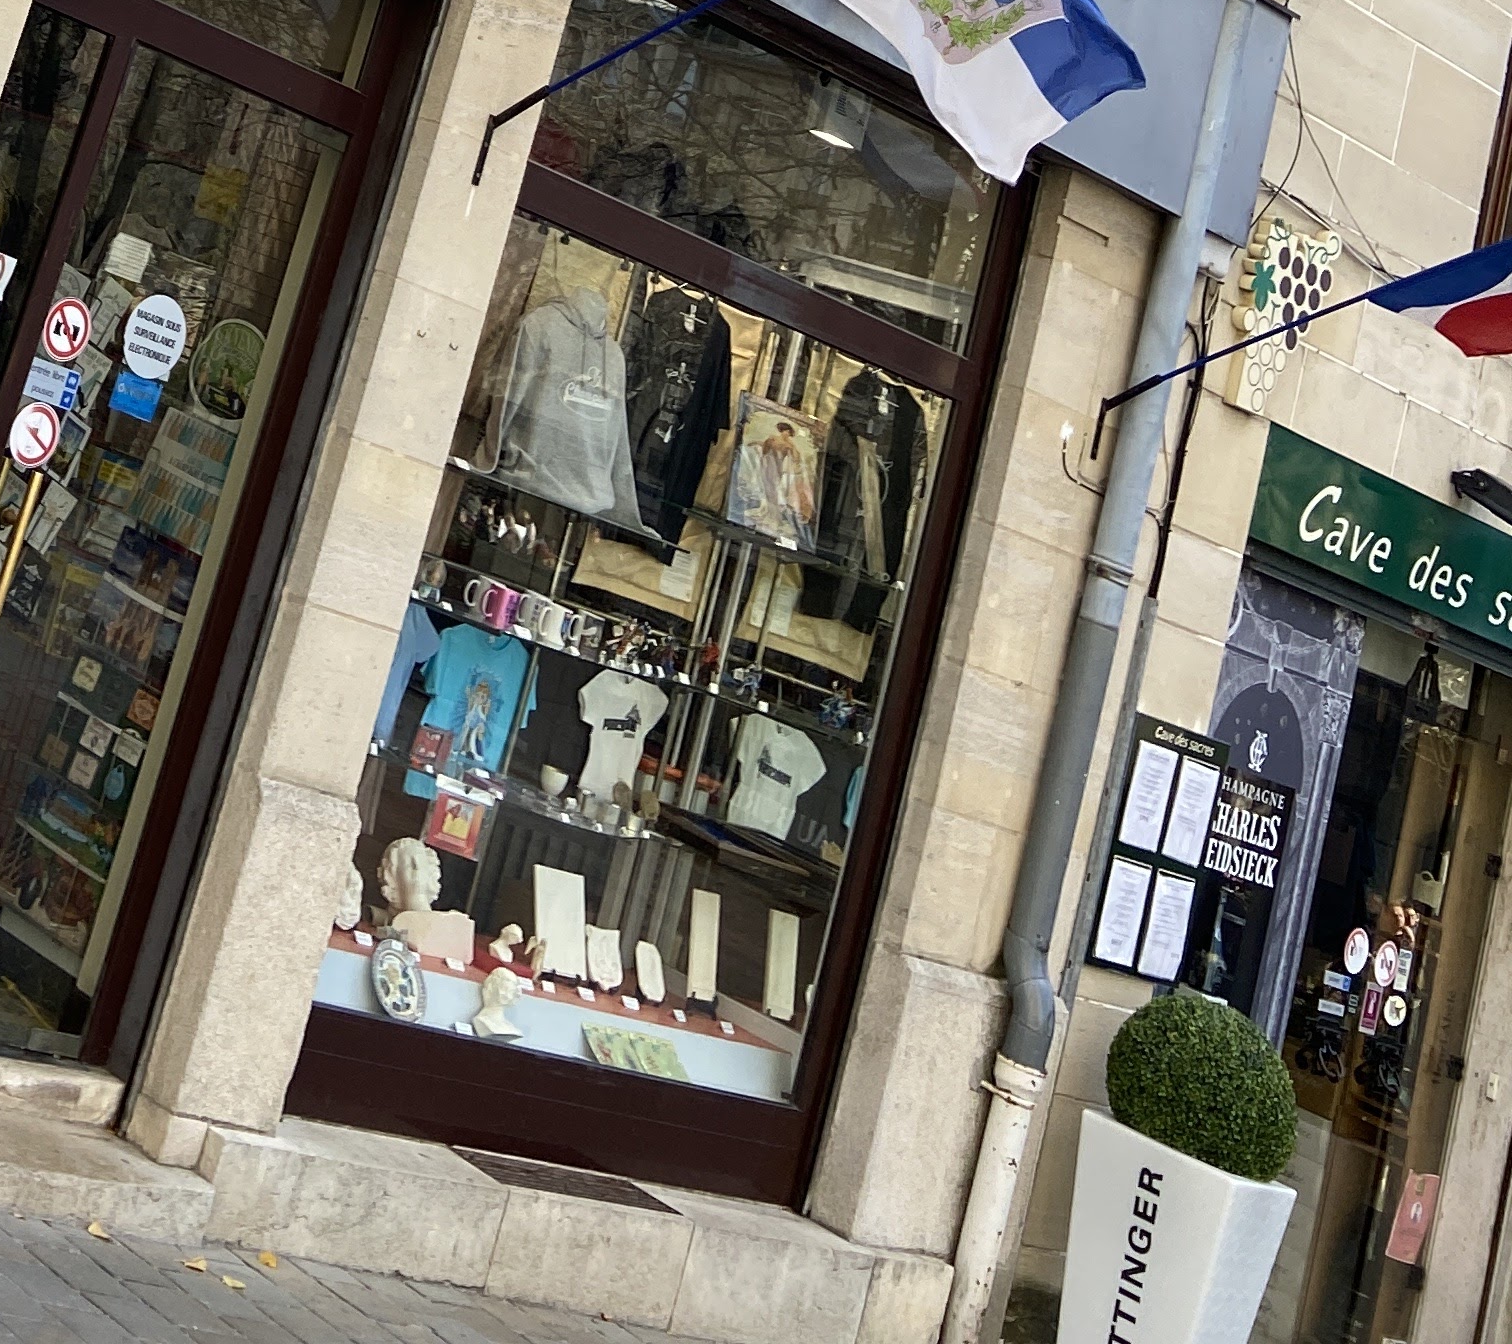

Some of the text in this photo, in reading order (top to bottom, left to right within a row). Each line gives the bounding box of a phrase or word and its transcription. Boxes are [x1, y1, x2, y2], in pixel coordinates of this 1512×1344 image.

[133, 326, 177, 349] SURVEILLANCE
[137, 308, 182, 333] MAGASIN SOUS
[1299, 485, 1512, 632] Cave des s
[1154, 725, 1216, 758] Cave des sacres
[1221, 775, 1286, 810] HAMPAGNE
[1212, 797, 1282, 851] HARLES
[1204, 837, 1279, 889] EIDSIECK
[1107, 1167, 1164, 1344] TTINGER
